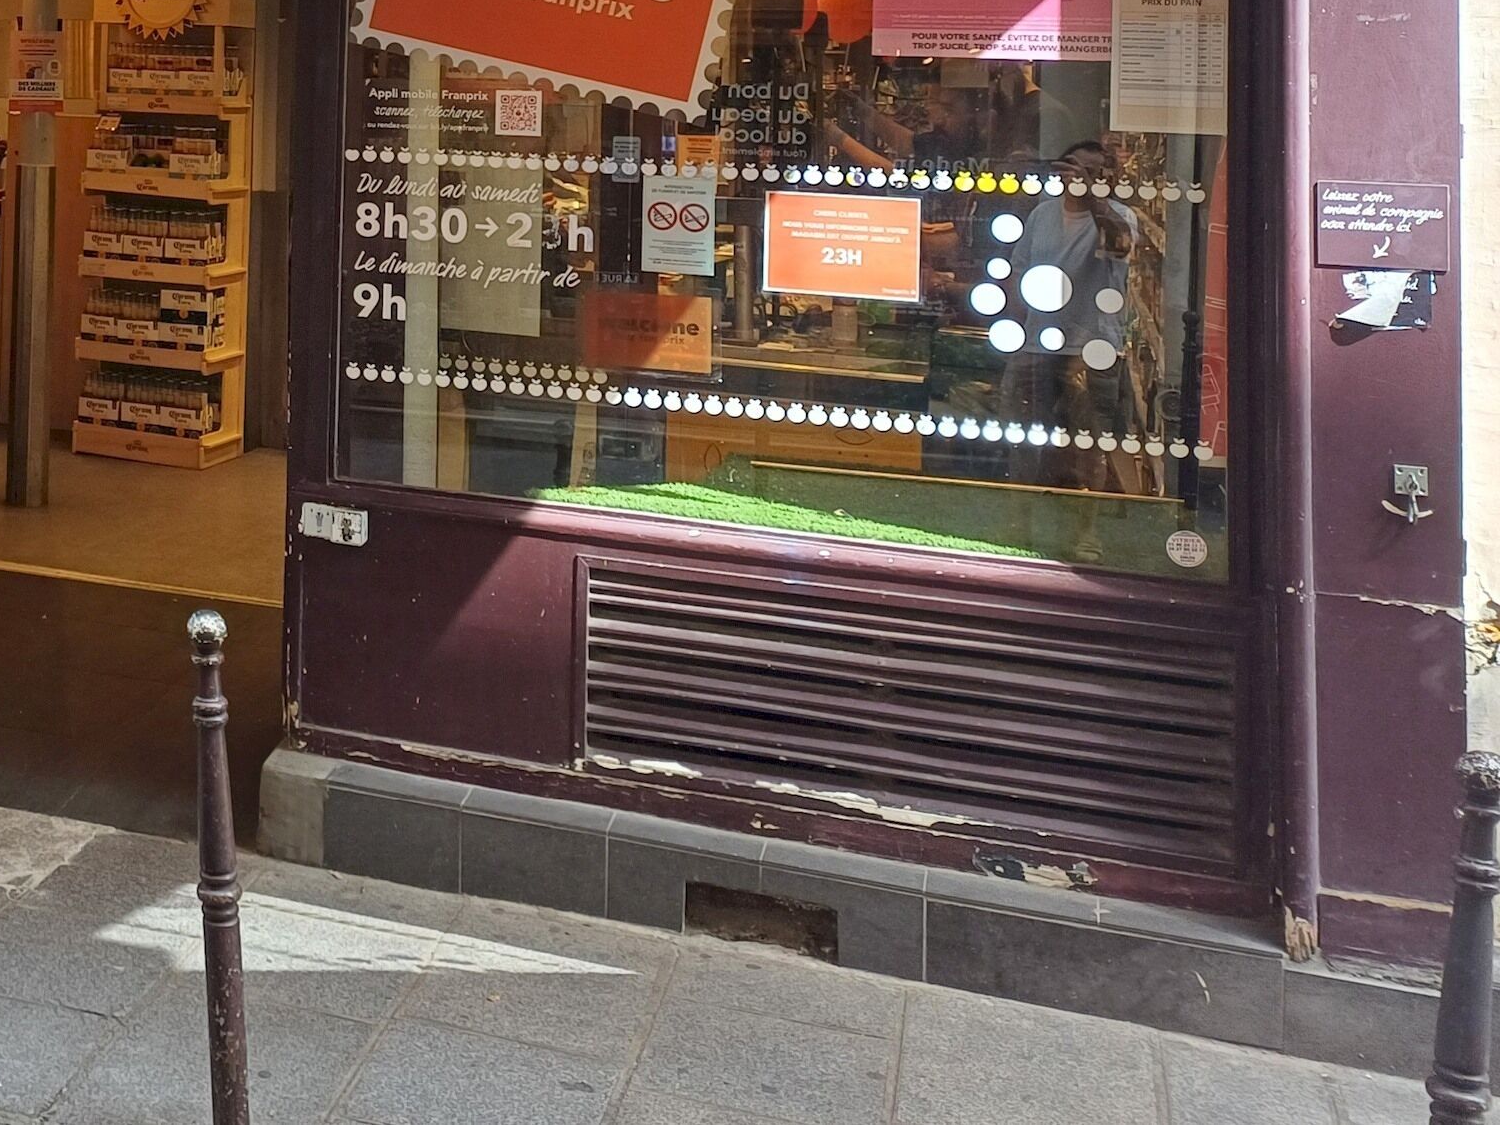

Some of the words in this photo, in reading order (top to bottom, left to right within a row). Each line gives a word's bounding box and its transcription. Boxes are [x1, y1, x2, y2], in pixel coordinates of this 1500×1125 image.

[911, 32, 938, 40] POUR
[940, 32, 970, 41] VOTRE
[1041, 34, 1054, 42] DE
[1057, 35, 1099, 43] MANGER
[912, 42, 938, 50] TROP
[974, 43, 998, 51] TROP
[368, 87, 398, 100] Appli
[401, 88, 438, 100] mobile
[441, 89, 490, 103] Franprix
[356, 172, 383, 194] Du
[383, 174, 438, 196] lundi
[440, 179, 466, 199] au
[472, 182, 541, 204] samedi
[1362, 191, 1394, 203] votre
[355, 202, 468, 244] 8h30
[1361, 202, 1376, 216] de
[1379, 207, 1445, 225] compagnie
[1347, 218, 1395, 232] attendre
[820, 246, 863, 266] 23H
[354, 251, 376, 272] Le
[379, 252, 468, 279] dimanche
[470, 260, 487, 281] à
[484, 263, 551, 289] partir
[553, 264, 581, 288] de
[353, 282, 407, 321] 9h
